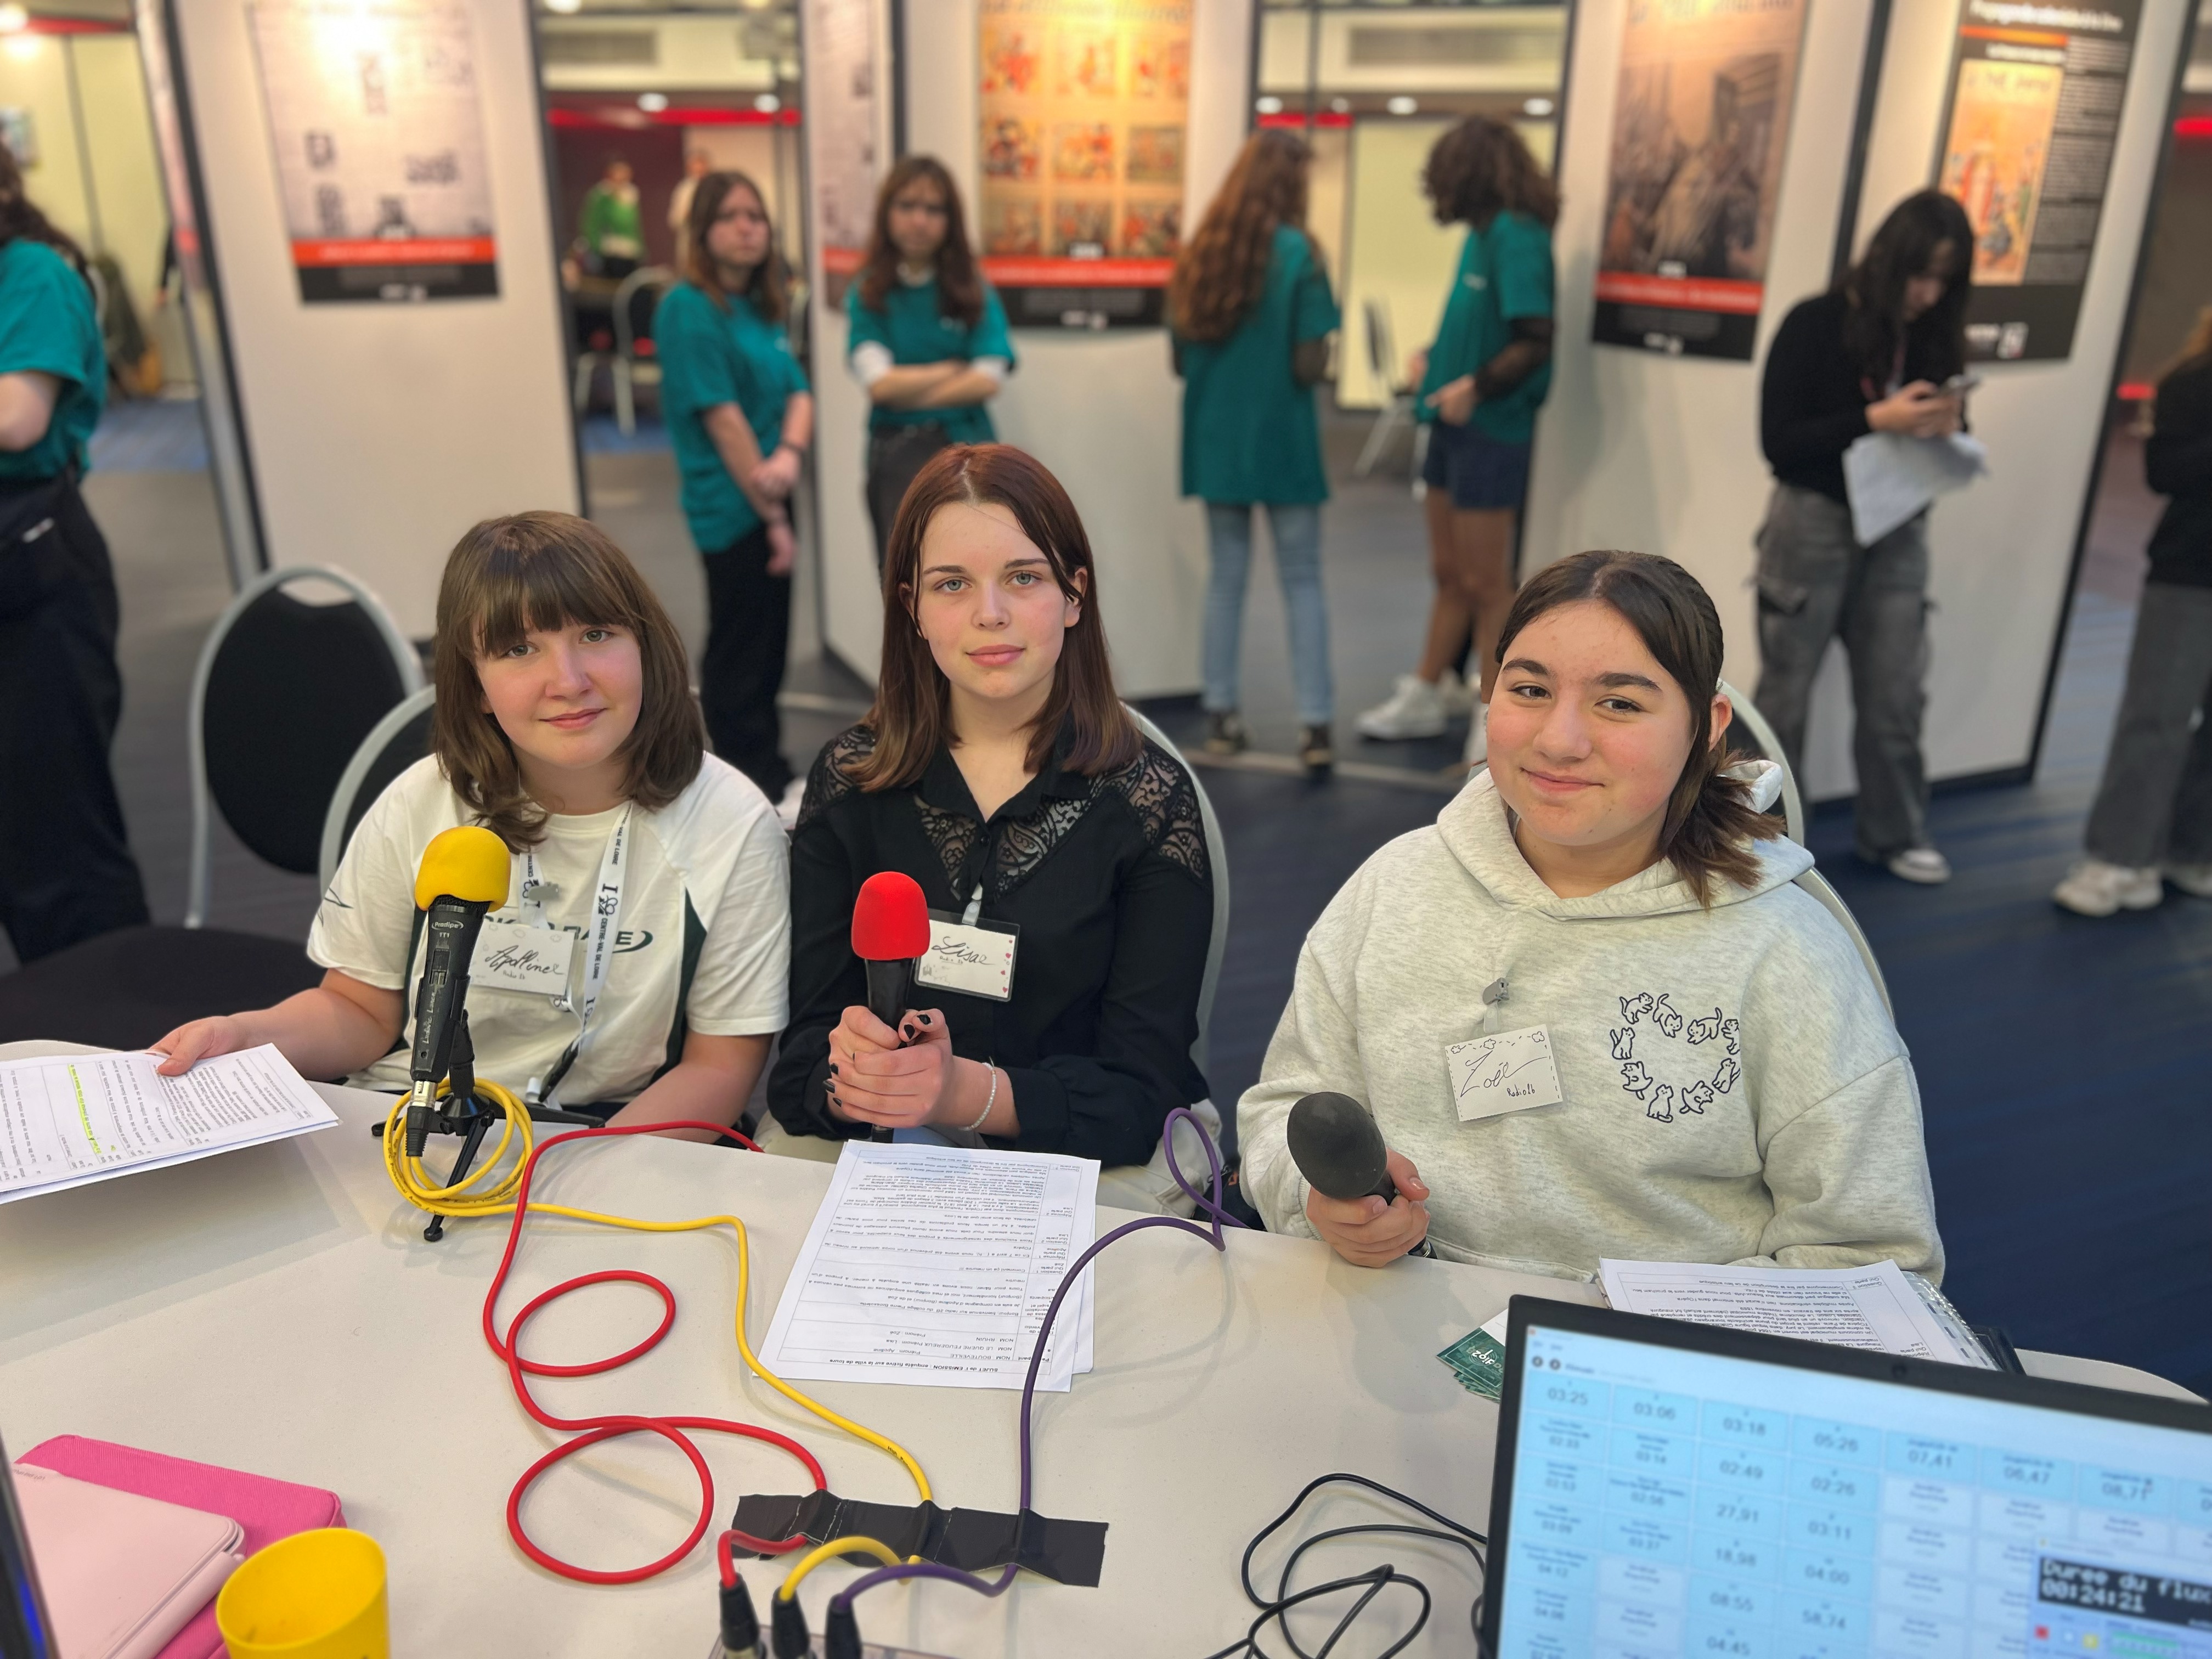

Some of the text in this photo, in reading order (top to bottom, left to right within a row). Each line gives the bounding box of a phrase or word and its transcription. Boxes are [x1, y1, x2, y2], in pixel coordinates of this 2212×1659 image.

[597, 918, 608, 952] CENTRE-VAL
[485, 945, 550, 973] Apolline
[931, 936, 979, 963] Lisa
[1723, 1417, 1766, 1437] 03:18
